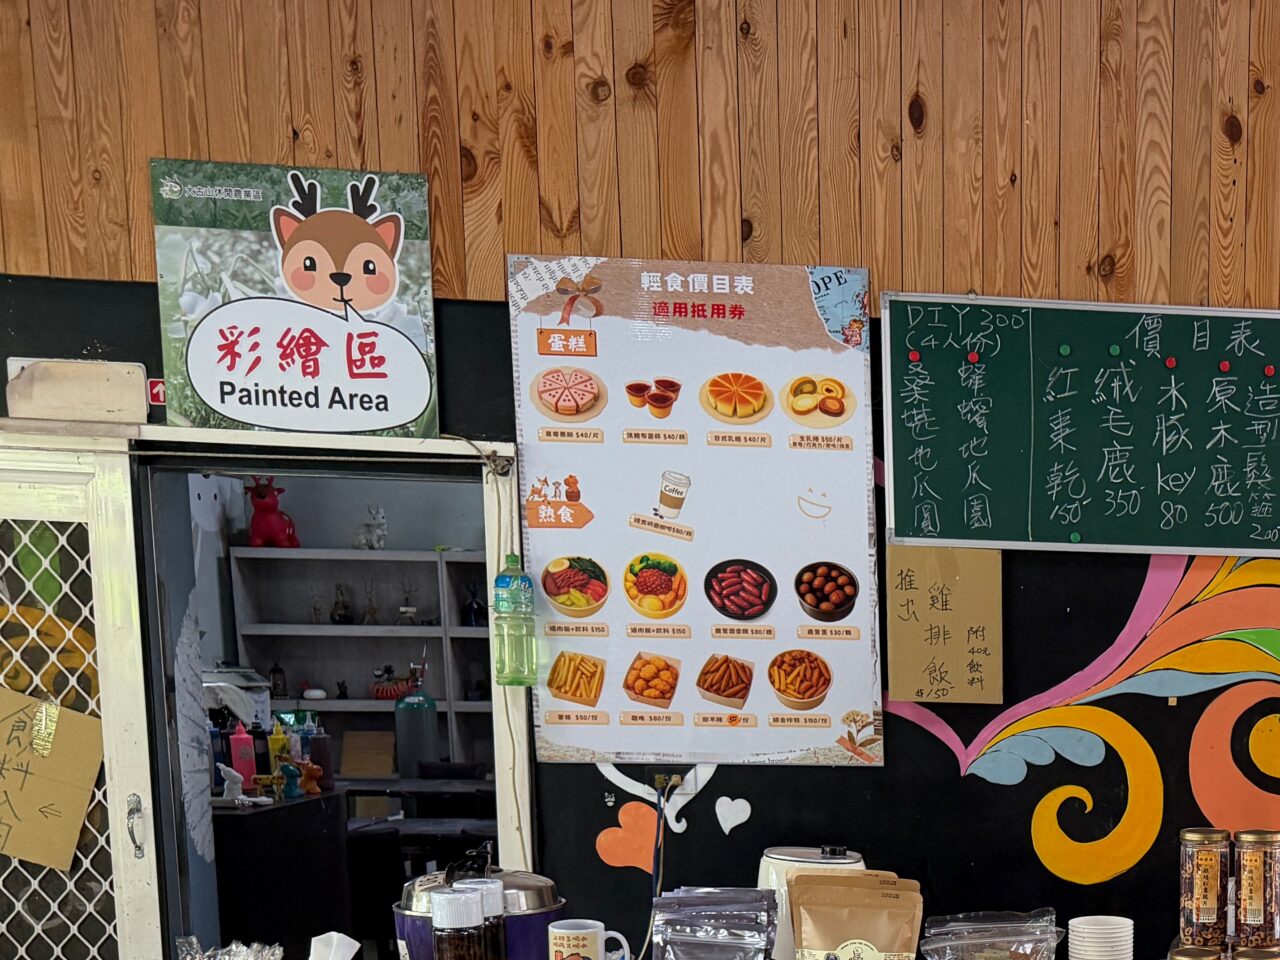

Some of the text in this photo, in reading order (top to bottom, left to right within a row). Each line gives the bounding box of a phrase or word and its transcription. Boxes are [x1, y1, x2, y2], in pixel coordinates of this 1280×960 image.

[640, 271, 755, 295] 輕食價目表
[652, 301, 746, 320] 適用抵用券
[907, 305, 970, 335] DIY
[216, 324, 388, 380] 彩繪區
[548, 334, 587, 352] 蛋糕
[219, 381, 390, 412] Painted Area
[664, 485, 684, 496] Coffee
[538, 505, 575, 524] 熱食
[1204, 501, 1245, 527] 500
[895, 568, 920, 622] 推出
[922, 582, 953, 686] 雞排飯
